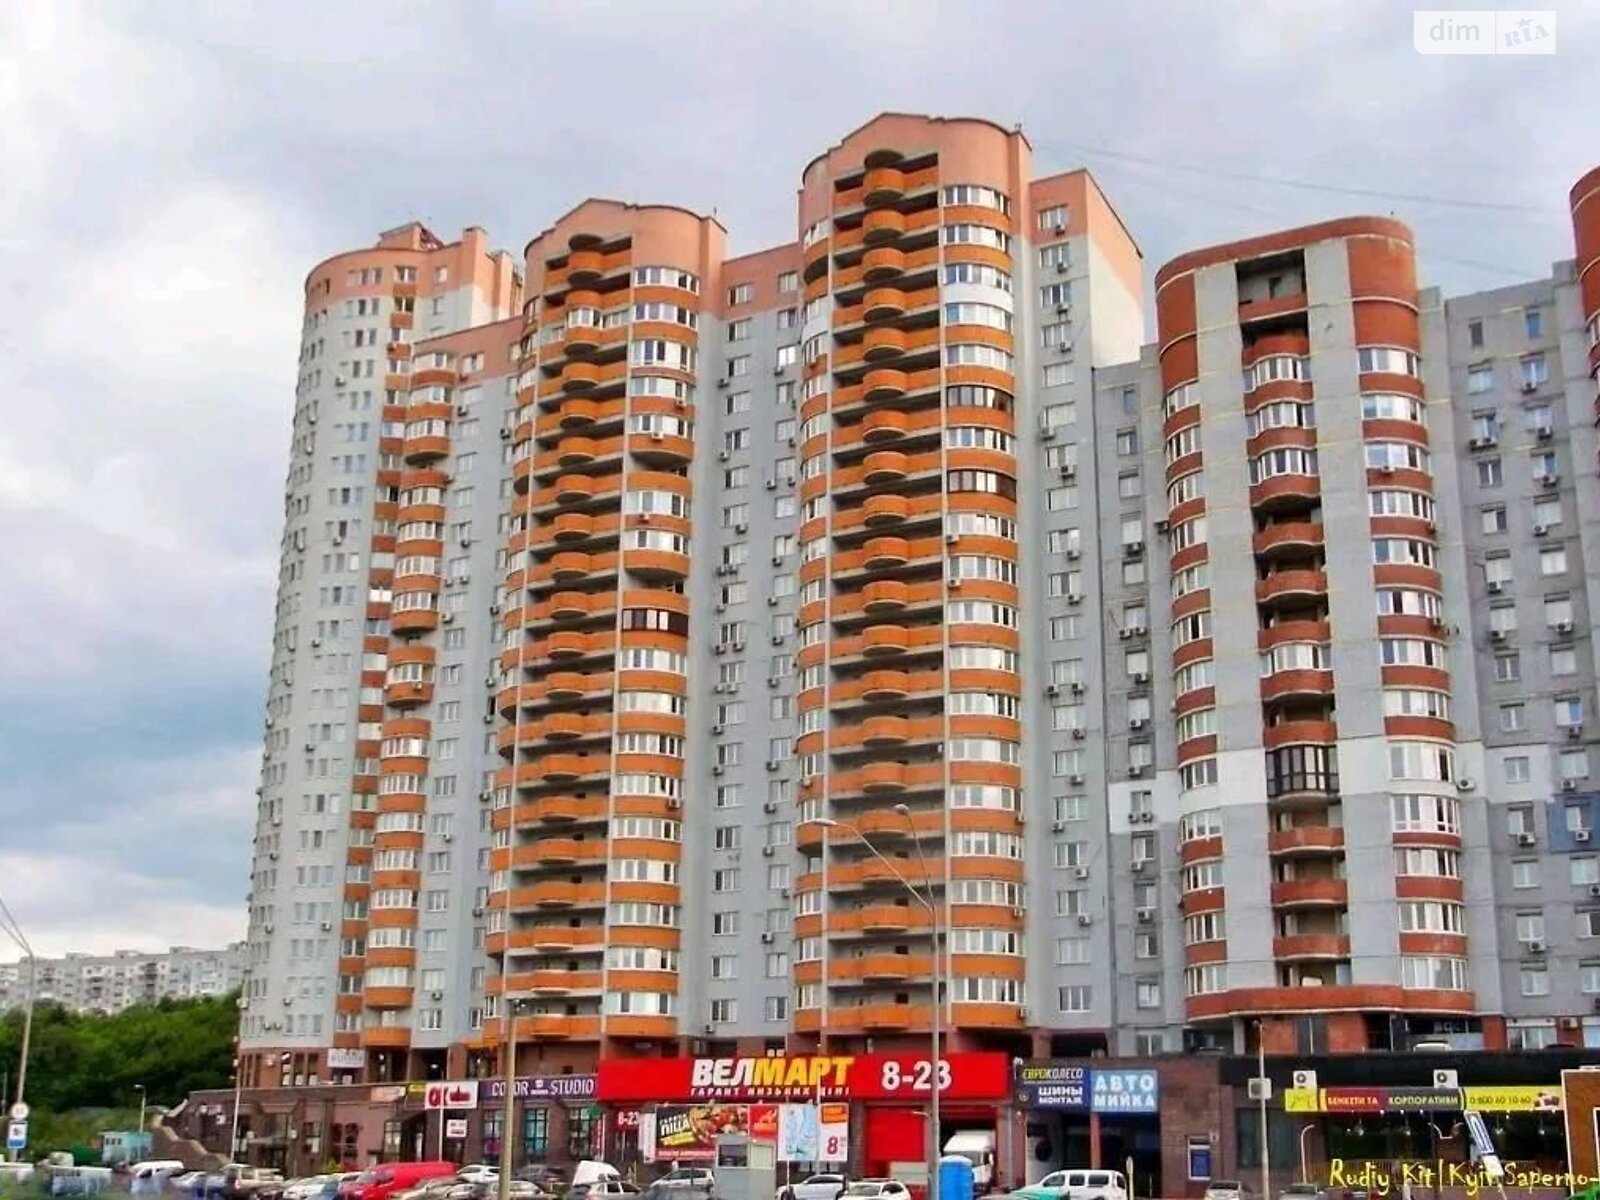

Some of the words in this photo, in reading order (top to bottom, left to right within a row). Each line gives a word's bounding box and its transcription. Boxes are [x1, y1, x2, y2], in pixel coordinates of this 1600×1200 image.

[691, 1056, 855, 1087] ВЕЛМАРТ
[881, 1060, 952, 1091] 8-23
[550, 1078, 594, 1096] STUDIO
[1038, 1086, 1083, 1096] ШИНЫ
[1094, 1074, 1155, 1092] АВТО
[1094, 1090, 1156, 1108] МИЙКА
[827, 1136, 839, 1155] 8
